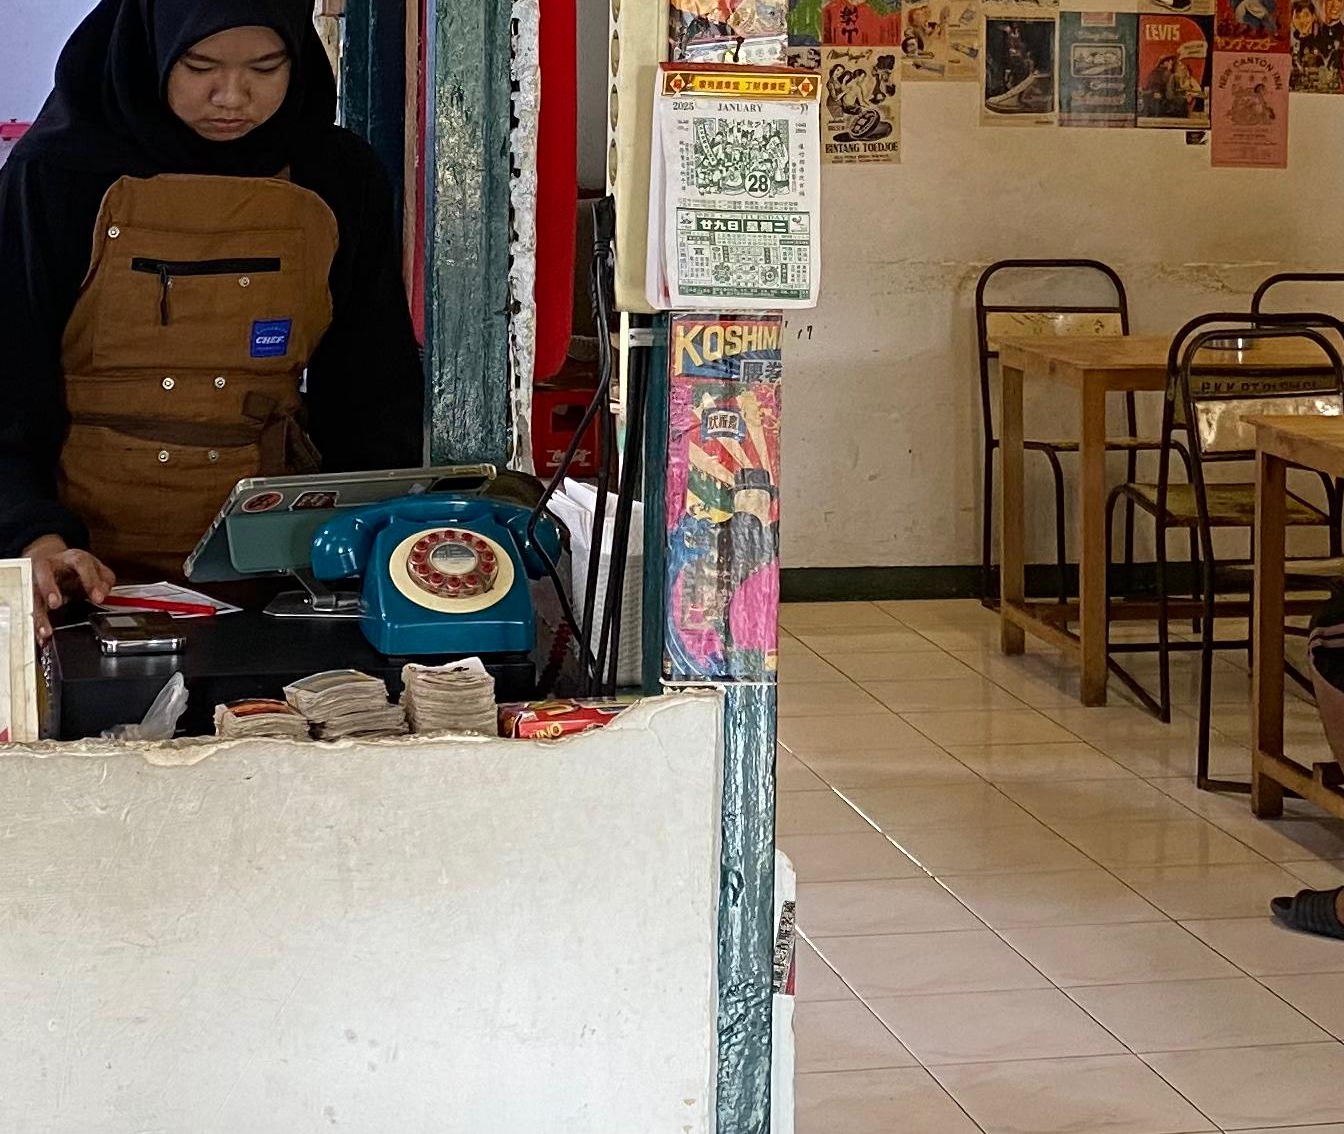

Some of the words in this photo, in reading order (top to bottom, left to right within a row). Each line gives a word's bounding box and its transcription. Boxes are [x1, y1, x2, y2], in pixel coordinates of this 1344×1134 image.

[1232, 56, 1274, 72] CANTON
[717, 102, 764, 113] JANUARY
[825, 143, 861, 154] BINTANG
[746, 173, 769, 193] 28
